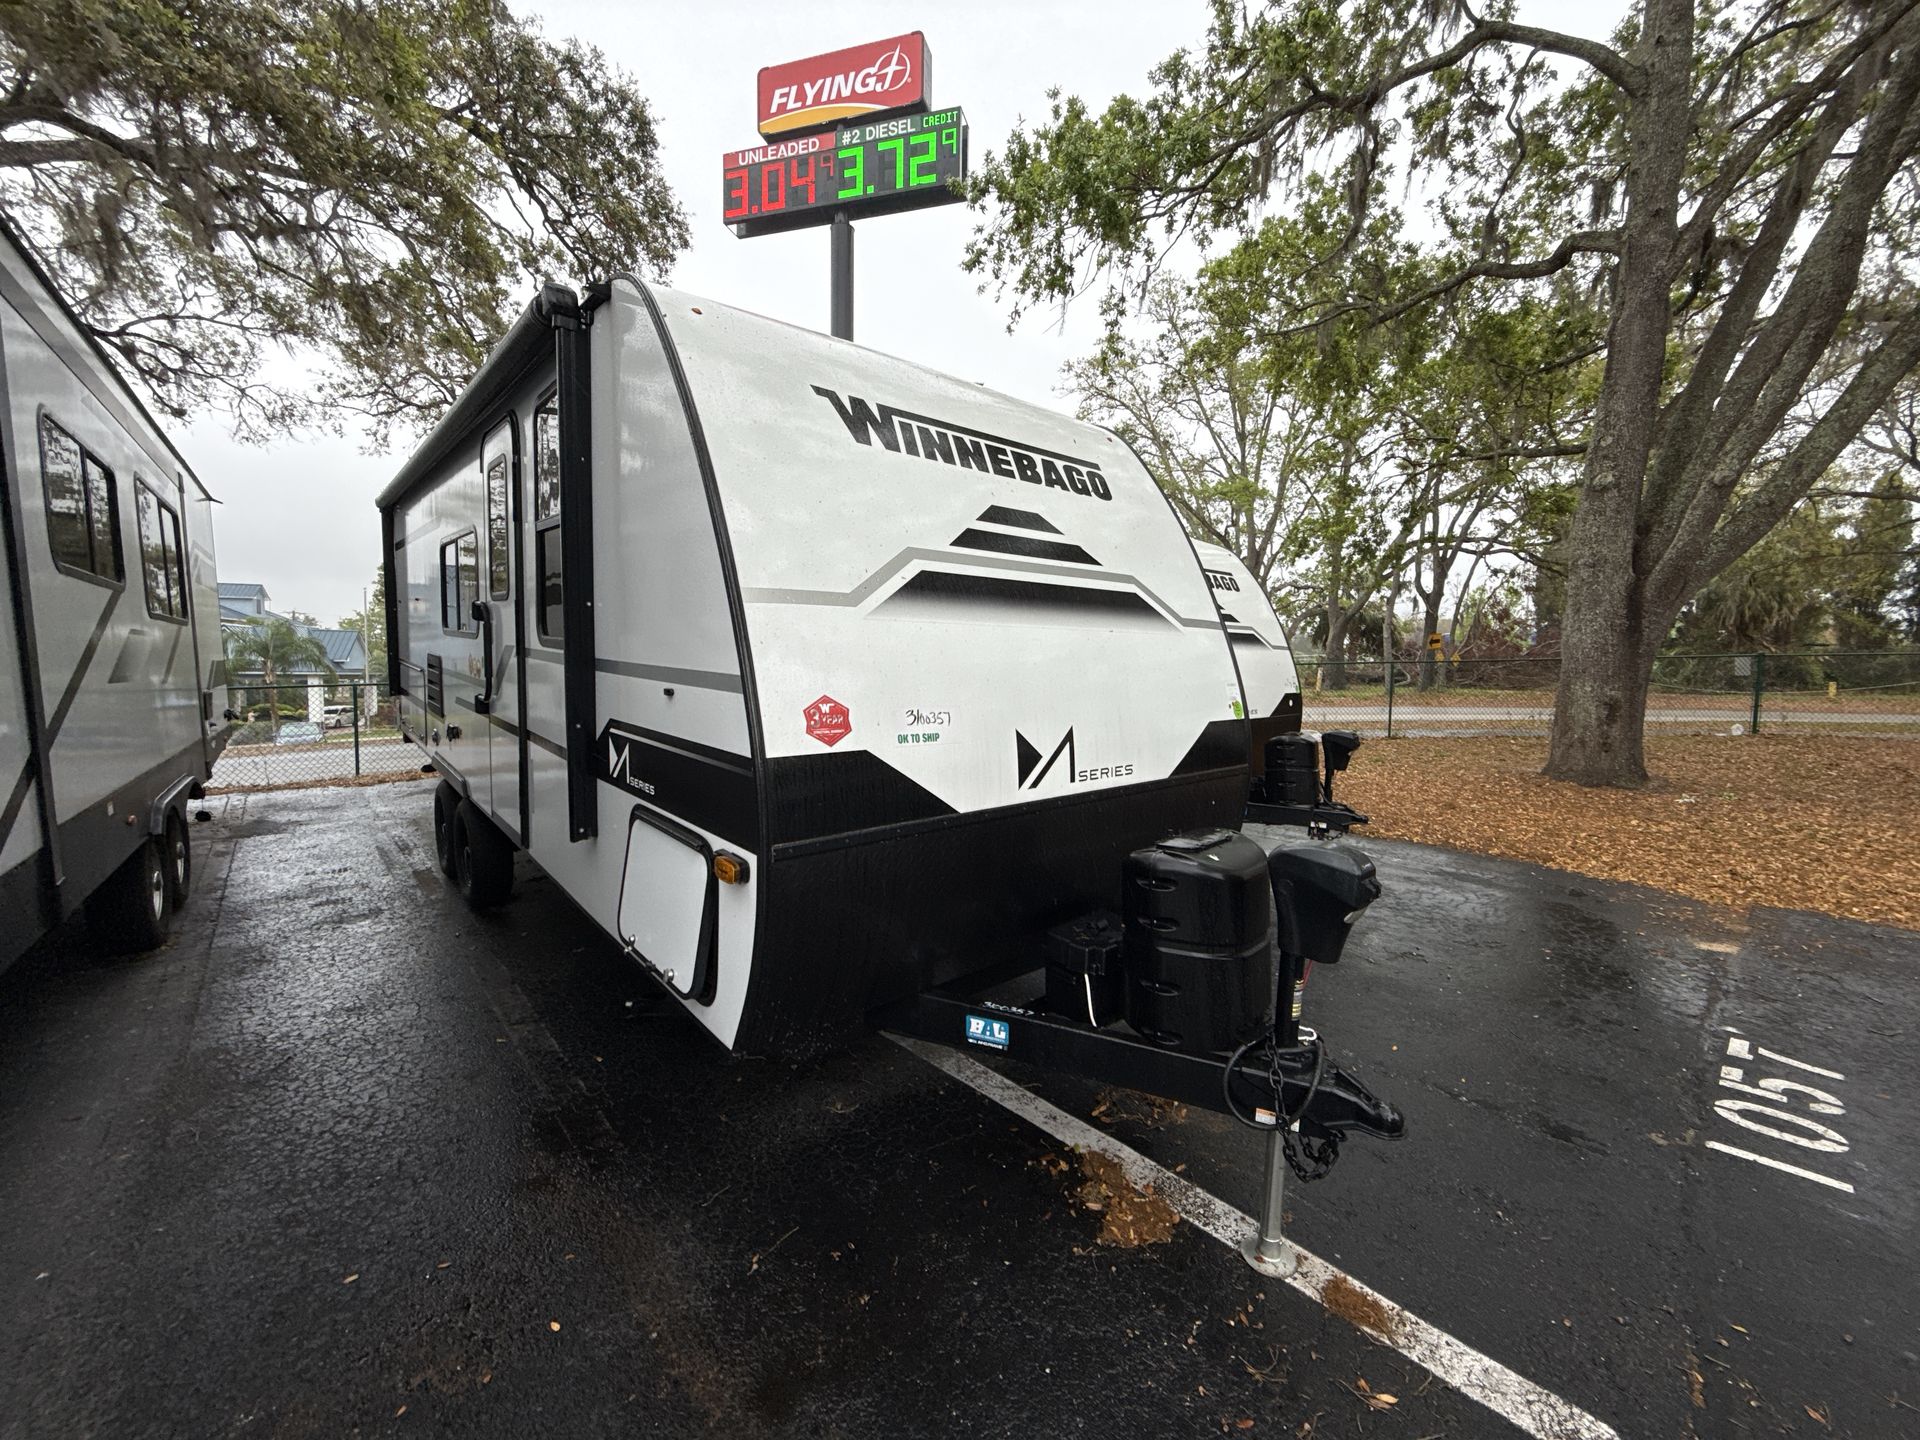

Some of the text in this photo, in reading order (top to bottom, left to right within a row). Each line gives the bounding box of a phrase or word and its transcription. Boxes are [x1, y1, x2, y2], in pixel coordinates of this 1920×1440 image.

[770, 66, 876, 113] FLYING
[841, 119, 916, 146] #2 DIESEL
[923, 111, 958, 127] CREDIT
[738, 138, 820, 165] UNLEADED
[810, 384, 1112, 501] WINNEBAGO
[897, 732, 940, 744] OK TO SHIP
[629, 776, 655, 795] SERIES
[1078, 764, 1134, 782] SERIES
[1705, 1037, 1855, 1193] 1057
